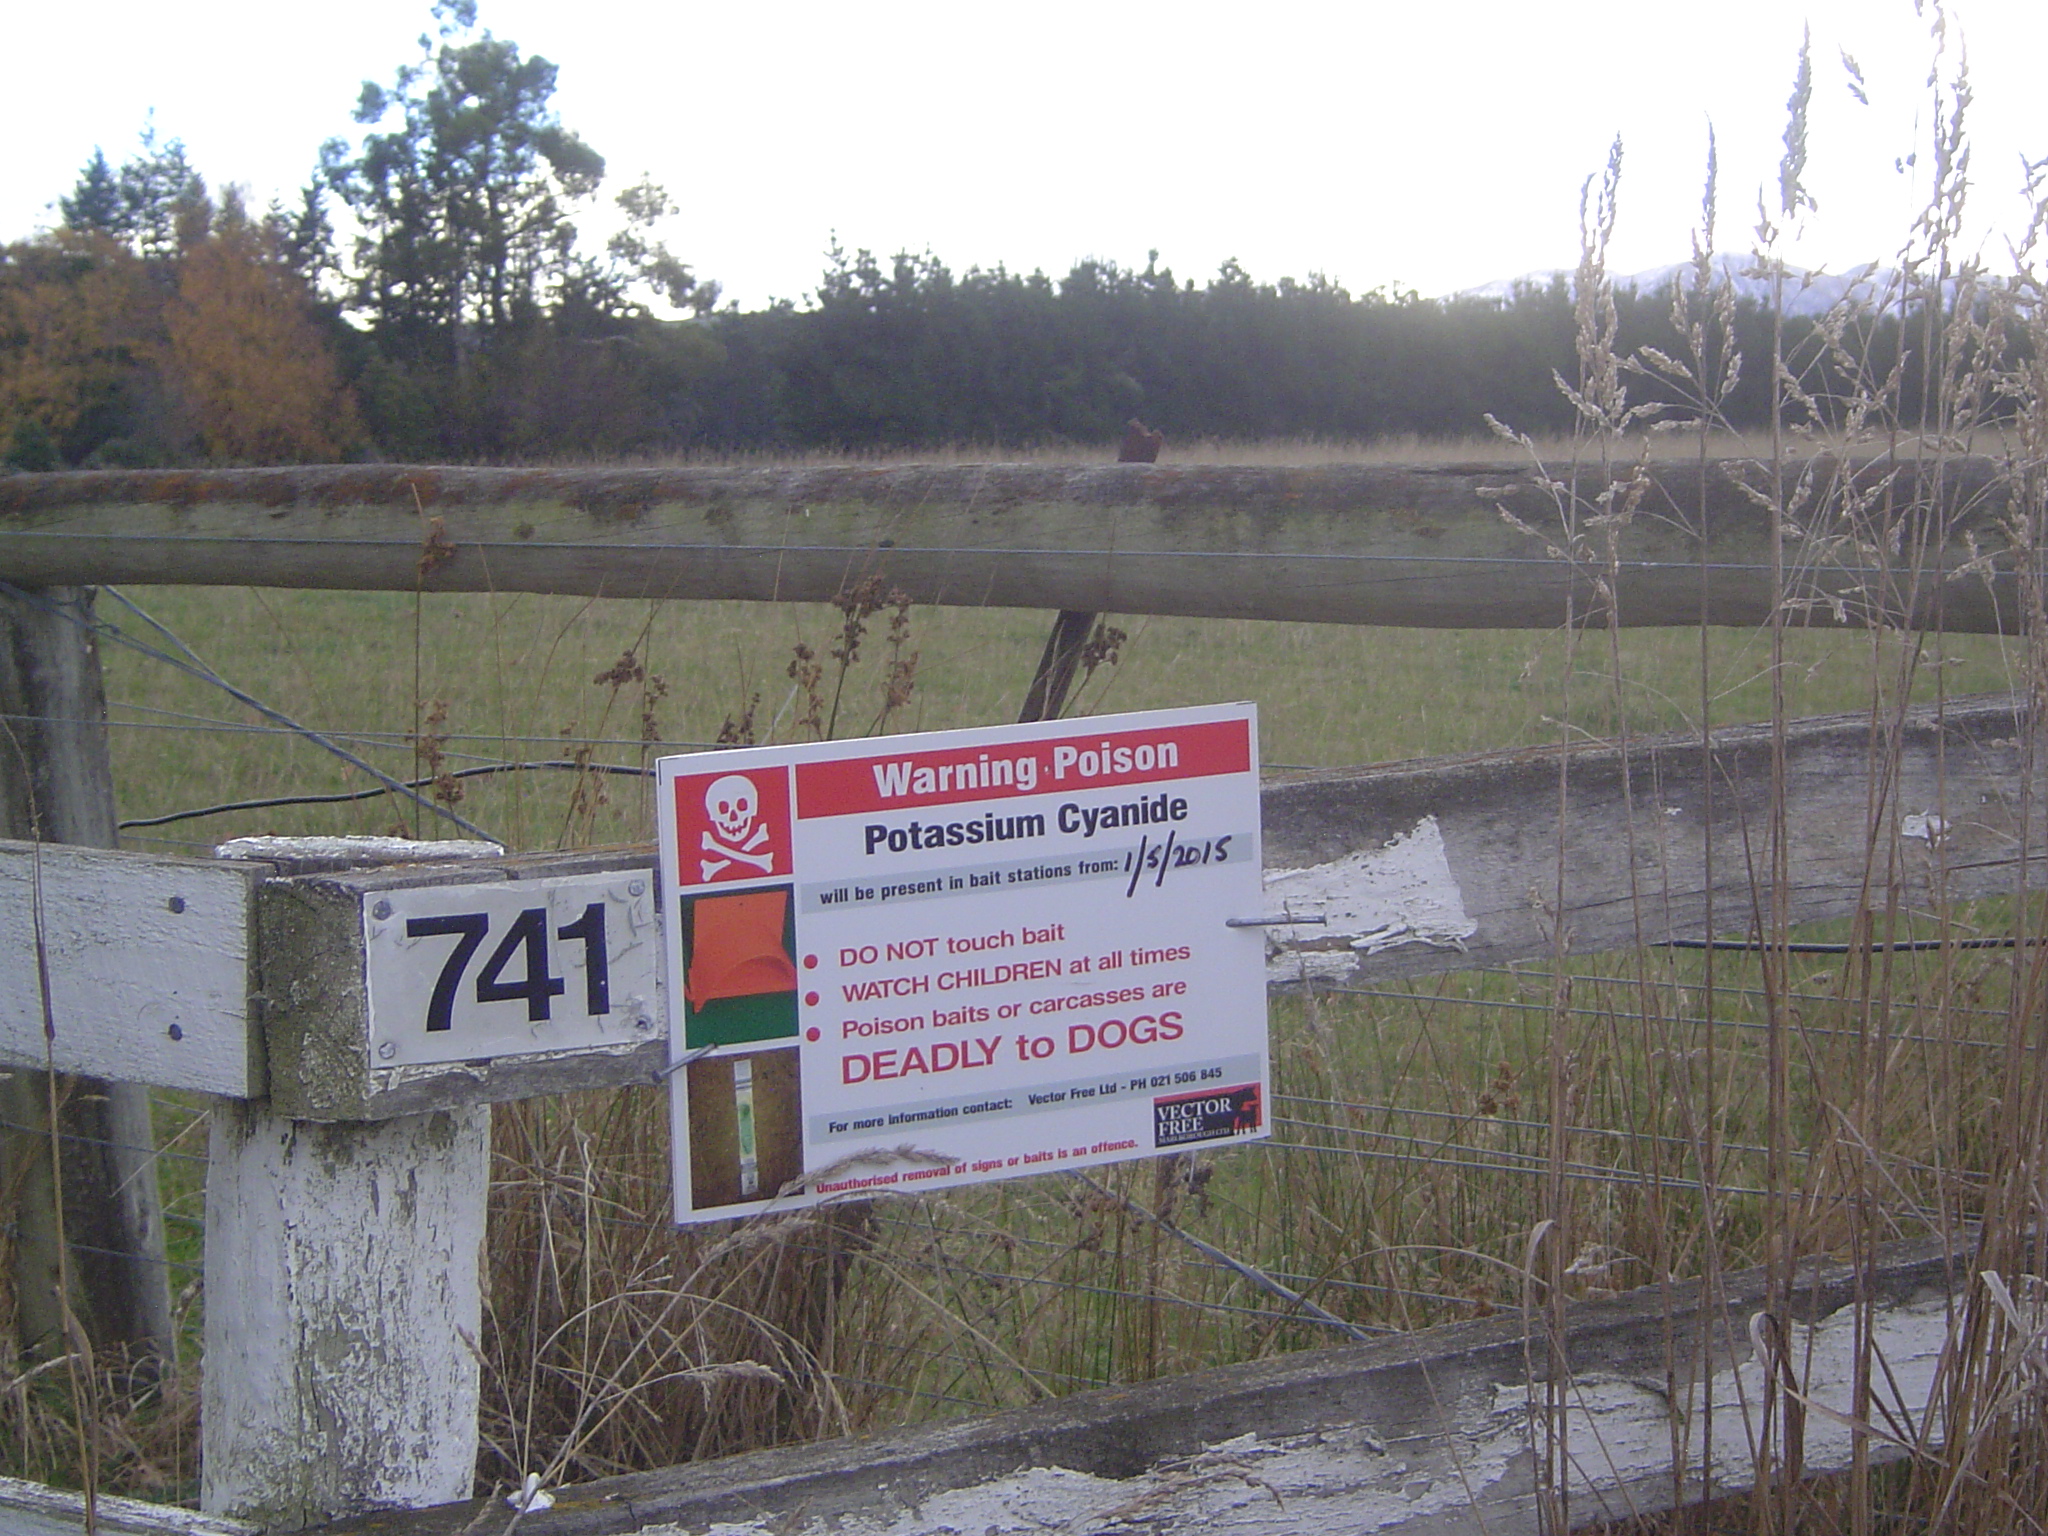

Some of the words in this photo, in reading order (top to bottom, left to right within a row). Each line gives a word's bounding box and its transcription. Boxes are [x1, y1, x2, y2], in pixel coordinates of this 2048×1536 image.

[873, 754, 1038, 798] Warning
[1054, 741, 1179, 780] Poison
[865, 812, 1045, 855] Potassium
[1058, 793, 1188, 838] Cyanide
[820, 888, 849, 905] will
[854, 886, 875, 902] be
[881, 877, 943, 900] present
[949, 875, 964, 891] in
[970, 870, 1001, 888] bait
[1008, 864, 1072, 884] stations
[1078, 859, 1119, 875] from:
[1124, 830, 1232, 898] 1/5/2015
[406, 902, 610, 1032] 741
[840, 946, 878, 967] DO
[886, 938, 939, 961] NOT
[947, 929, 1014, 954] touch
[1022, 923, 1065, 946] bait
[842, 975, 929, 1003] WATCH
[937, 958, 1062, 991] CHILDREN
[1069, 956, 1091, 974] at
[1098, 950, 1123, 970] all
[1130, 943, 1191, 968] times
[842, 1014, 925, 1039] Poison
[932, 1005, 990, 1028] baits
[997, 1000, 1022, 1018] or
[1029, 985, 1145, 1015] carcasses
[1152, 980, 1187, 998] are
[842, 1035, 1002, 1085] DEADLY
[1015, 1032, 1055, 1062] to
[1068, 1011, 1184, 1054] DOGS
[1028, 1090, 1066, 1105] Vector
[1070, 1087, 1095, 1100] Free
[1099, 1083, 1117, 1095] Ltd
[1130, 1078, 1147, 1091] PH
[1150, 1074, 1171, 1088] 021
[1174, 1071, 1196, 1085] 506
[1200, 1067, 1222, 1081] 845
[1157, 1097, 1232, 1121] VECTOR
[829, 1121, 849, 1133] For
[853, 1117, 884, 1130] more
[962, 1098, 1013, 1115] contact:
[1158, 1117, 1204, 1137] FREE
[816, 1172, 899, 1194] Unauthorised
[903, 1164, 950, 1182] removal
[955, 1161, 967, 1174] of
[972, 1156, 1003, 1175] signs
[1007, 1156, 1019, 1166] or
[1024, 1150, 1053, 1164] baits
[1058, 1147, 1068, 1159] is
[1072, 1145, 1087, 1156] an
[1091, 1139, 1139, 1154] offence.
